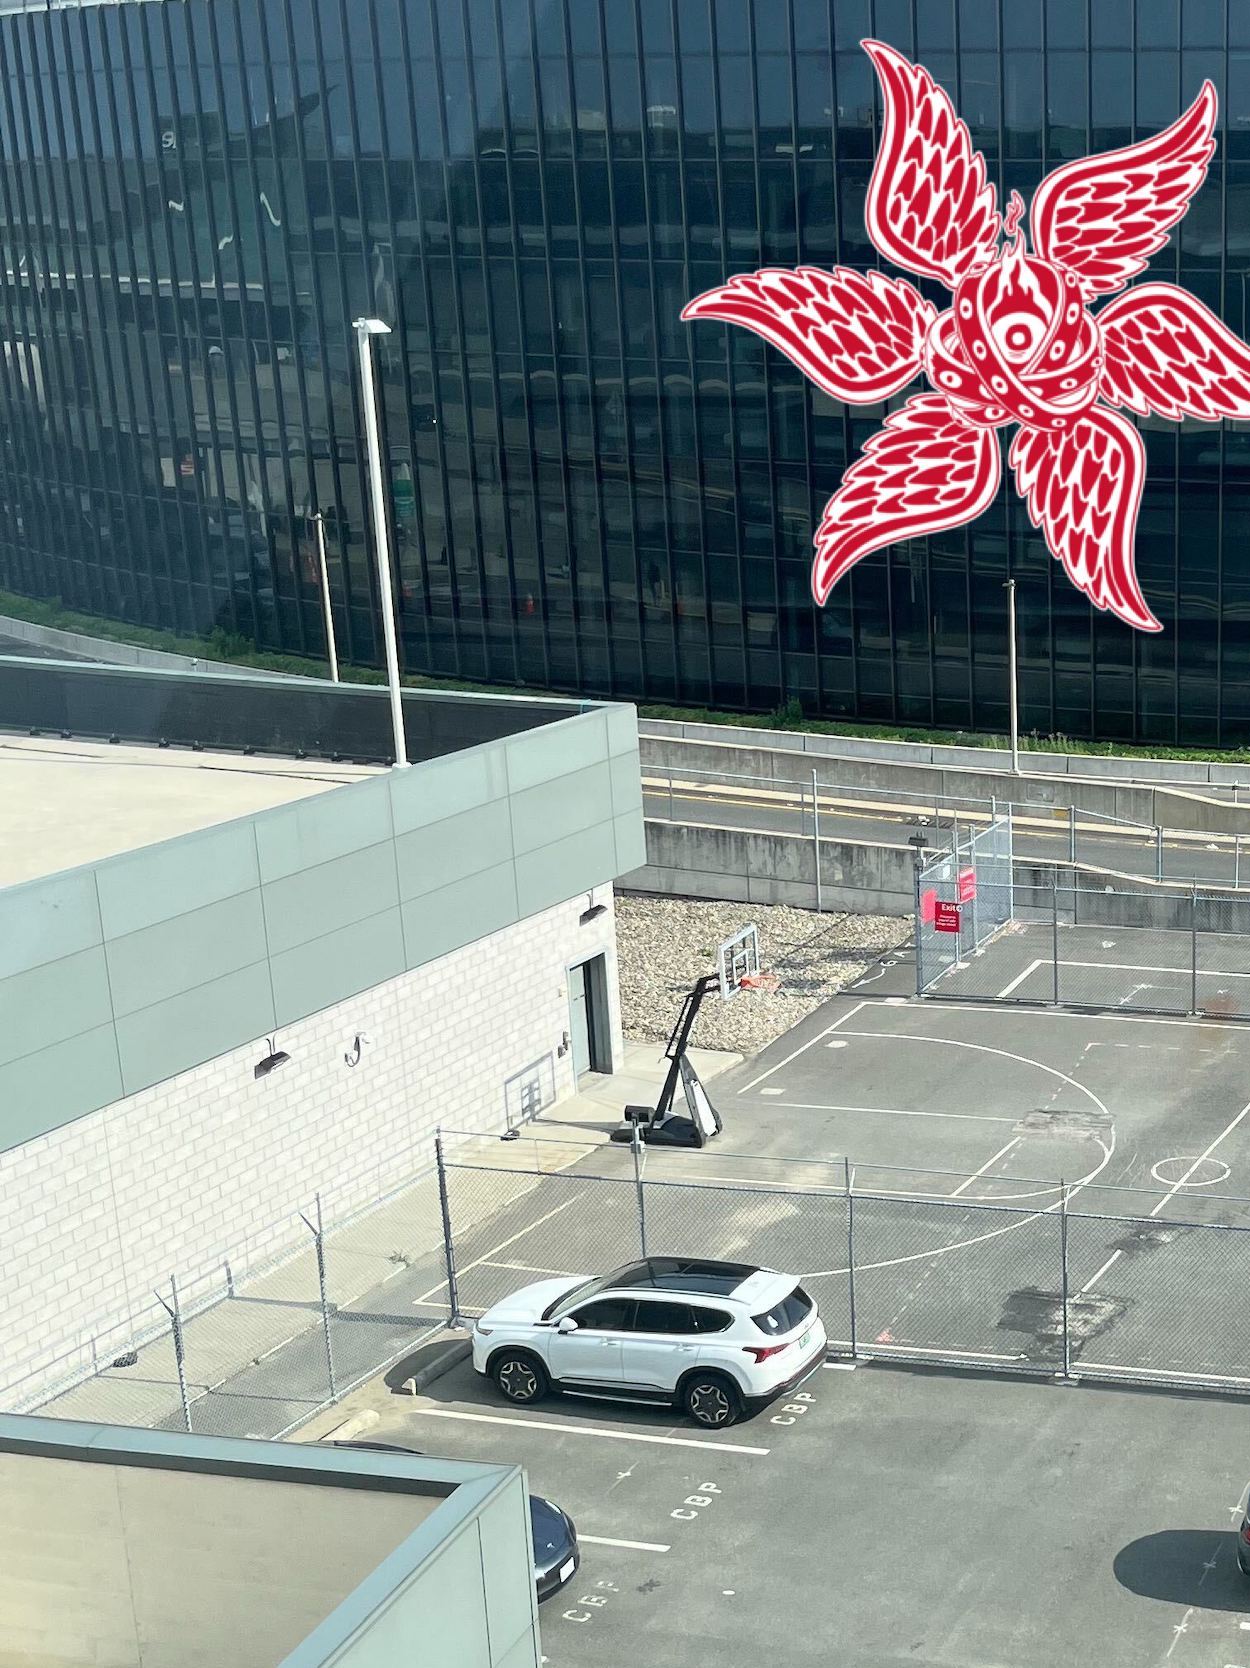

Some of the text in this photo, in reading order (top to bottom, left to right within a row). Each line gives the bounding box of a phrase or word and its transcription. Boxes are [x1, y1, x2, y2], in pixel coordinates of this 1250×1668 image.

[941, 903, 956, 912] Exit
[770, 1391, 816, 1425] CBP
[670, 1481, 723, 1521] CBP
